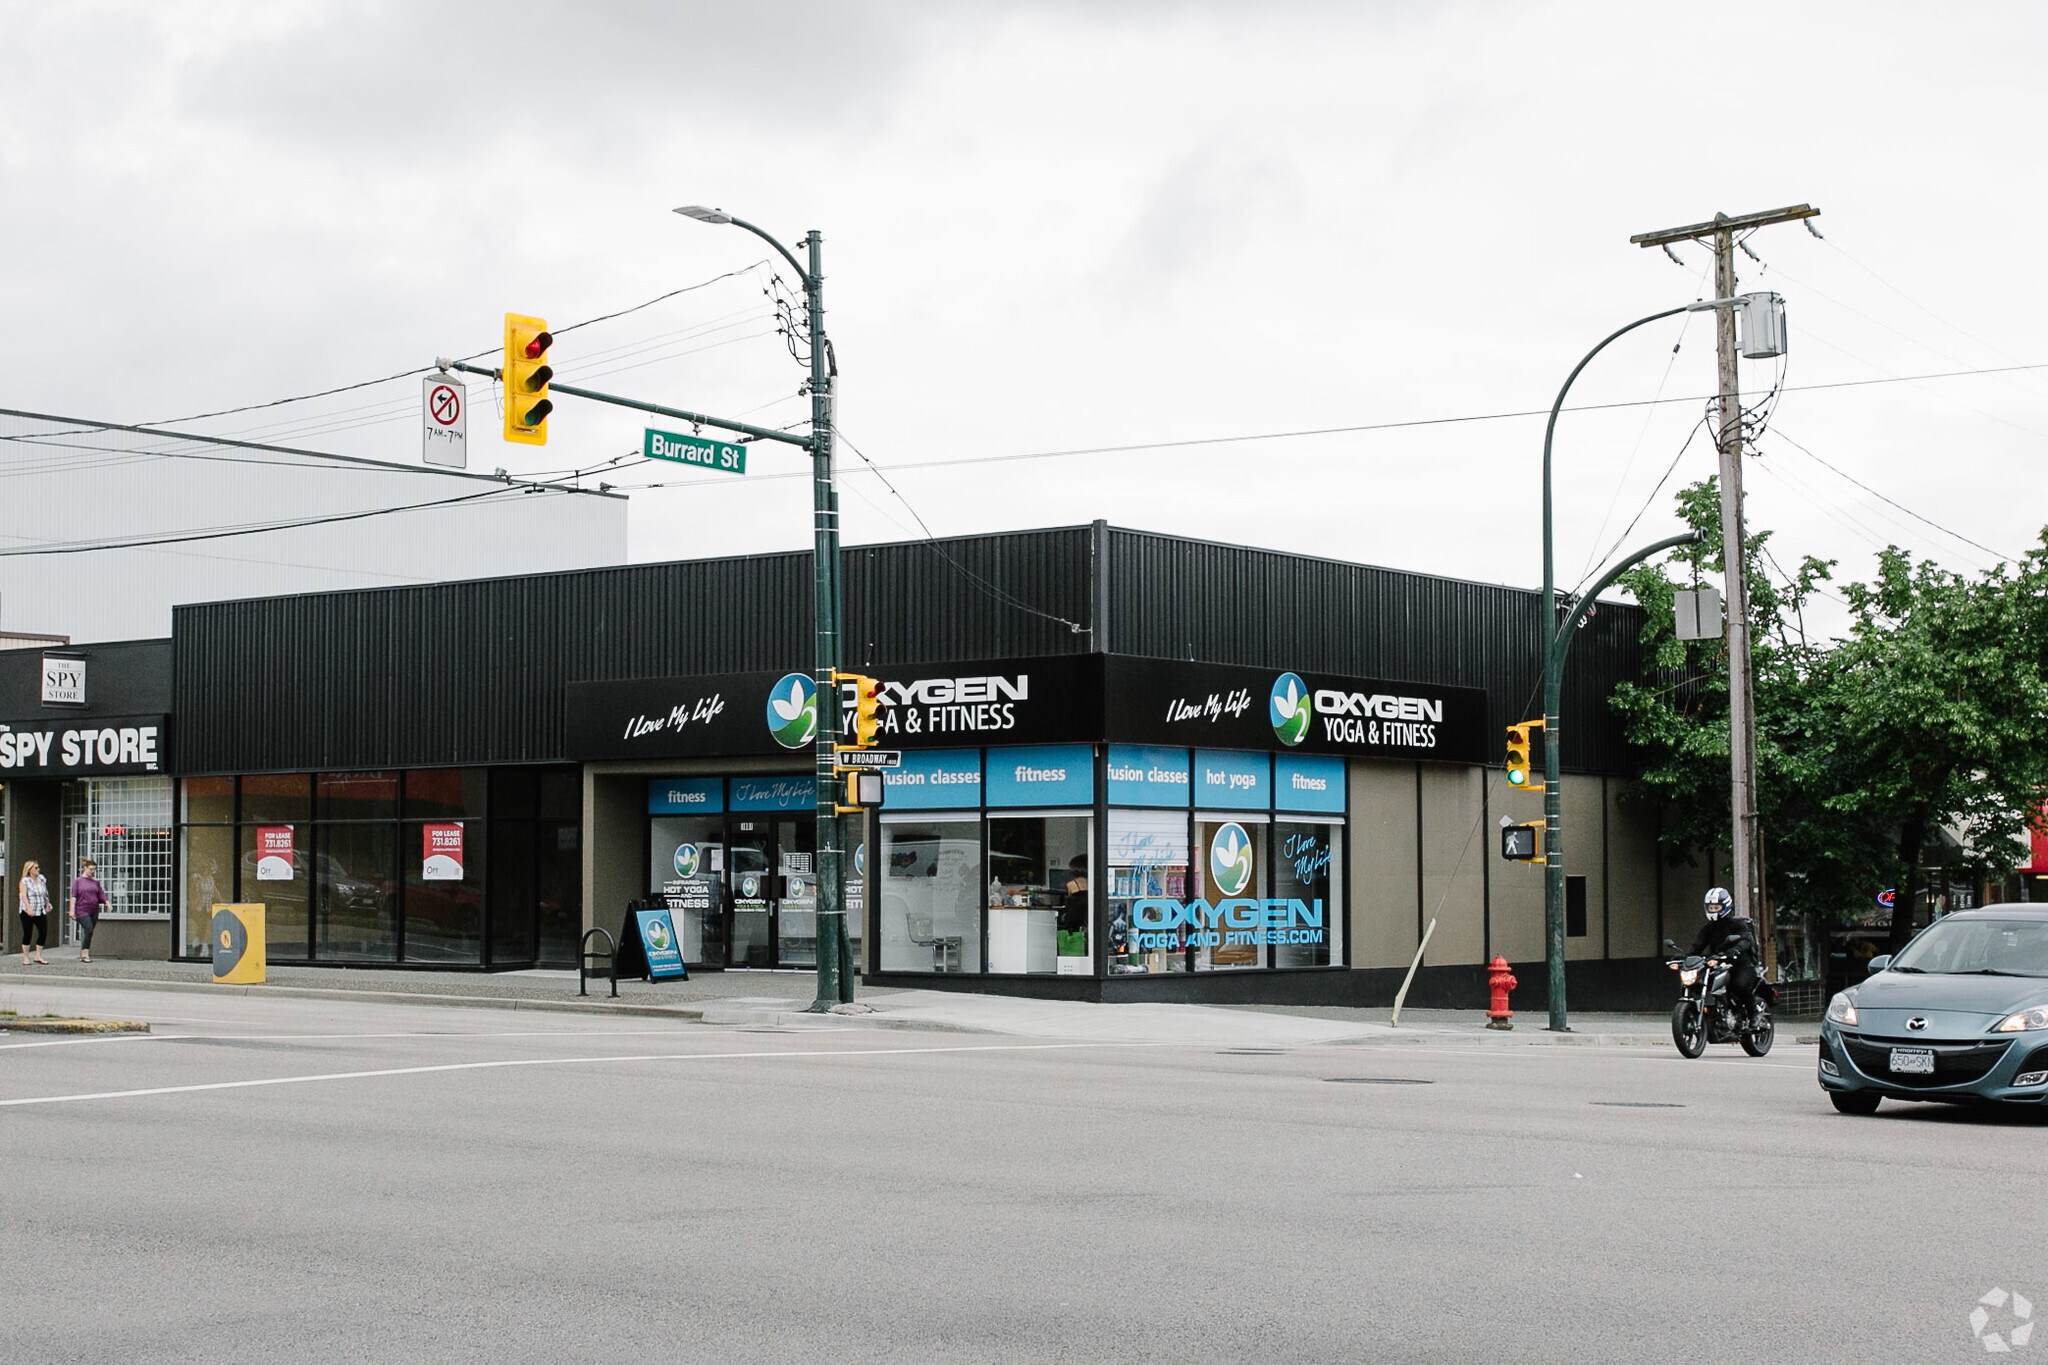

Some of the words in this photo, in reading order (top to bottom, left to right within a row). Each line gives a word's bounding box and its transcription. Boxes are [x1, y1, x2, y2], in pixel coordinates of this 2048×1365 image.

[651, 433, 715, 465] Burrard
[720, 446, 740, 469] St
[46, 671, 82, 688] SPY
[48, 690, 78, 700] STORE
[1174, 700, 1202, 722] Love
[1204, 694, 1222, 723] My
[1225, 688, 1251, 719] Life
[1314, 689, 1442, 722] OXYGEN
[633, 715, 665, 738] Love
[667, 704, 689, 733] My
[691, 693, 725, 725] Life
[843, 707, 899, 736] YA
[905, 707, 922, 733] &
[929, 703, 1015, 732] FITNESS
[1324, 717, 1365, 743] YOGA
[1368, 720, 1380, 745] &
[1383, 721, 1436, 748] FITNESS
[0, 732, 54, 768] SPY
[61, 727, 158, 766] STORE
[843, 754, 850, 763] W
[852, 753, 888, 764] BROADWAY
[883, 771, 924, 786] fusion
[930, 769, 981, 785] classes
[1014, 765, 1066, 783] fitness
[1107, 764, 1143, 782] fusion
[1147, 767, 1188, 784] classes
[1206, 769, 1225, 785] hot
[1229, 773, 1256, 789] yoga
[1292, 773, 1327, 791] fitness
[668, 790, 706, 803] fitness
[749, 785, 771, 801] Love
[771, 782, 793, 807] My
[792, 780, 815, 805] Life
[1296, 833, 1316, 855] Love
[1294, 854, 1315, 885] My
[1313, 844, 1334, 876] Life
[663, 886, 681, 894] HOT
[684, 886, 709, 894] YOGA
[1132, 898, 1323, 930] OXYGEN
[1133, 931, 1180, 948] YOGA
[1185, 931, 1220, 947] AND
[1225, 929, 1323, 946] FITNESS.COM
